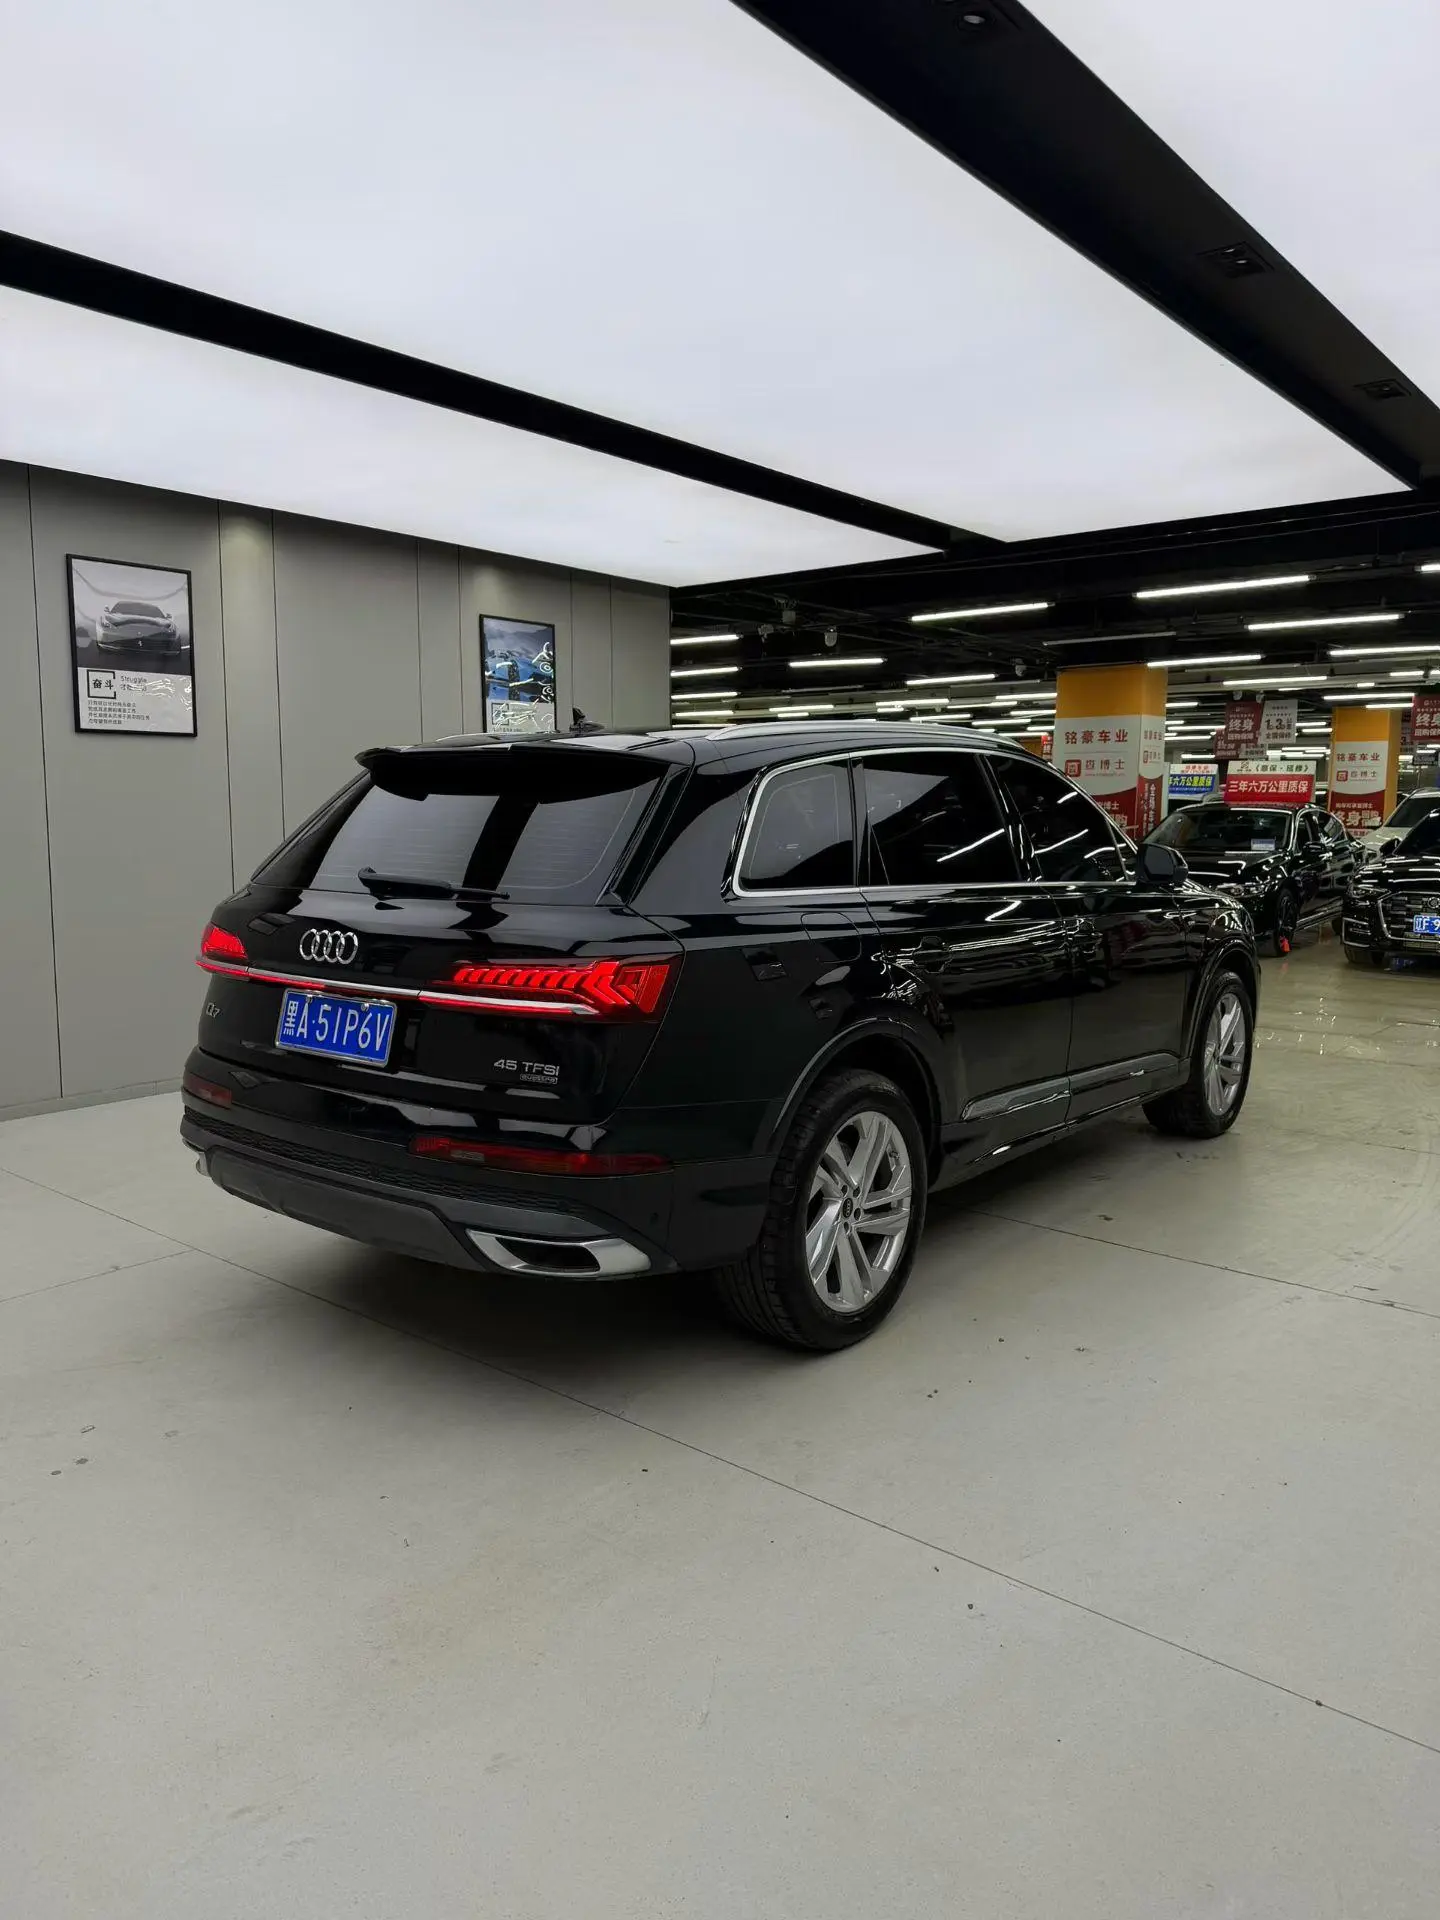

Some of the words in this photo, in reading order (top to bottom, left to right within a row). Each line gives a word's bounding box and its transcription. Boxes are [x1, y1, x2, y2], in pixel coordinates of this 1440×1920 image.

[92, 678, 114, 690] 奋斗
[1064, 728, 1129, 745] 铭豪车业
[1228, 780, 1309, 794] 三年六万公里质保
[493, 1059, 518, 1071] 45
[521, 1061, 560, 1077] TFSI
